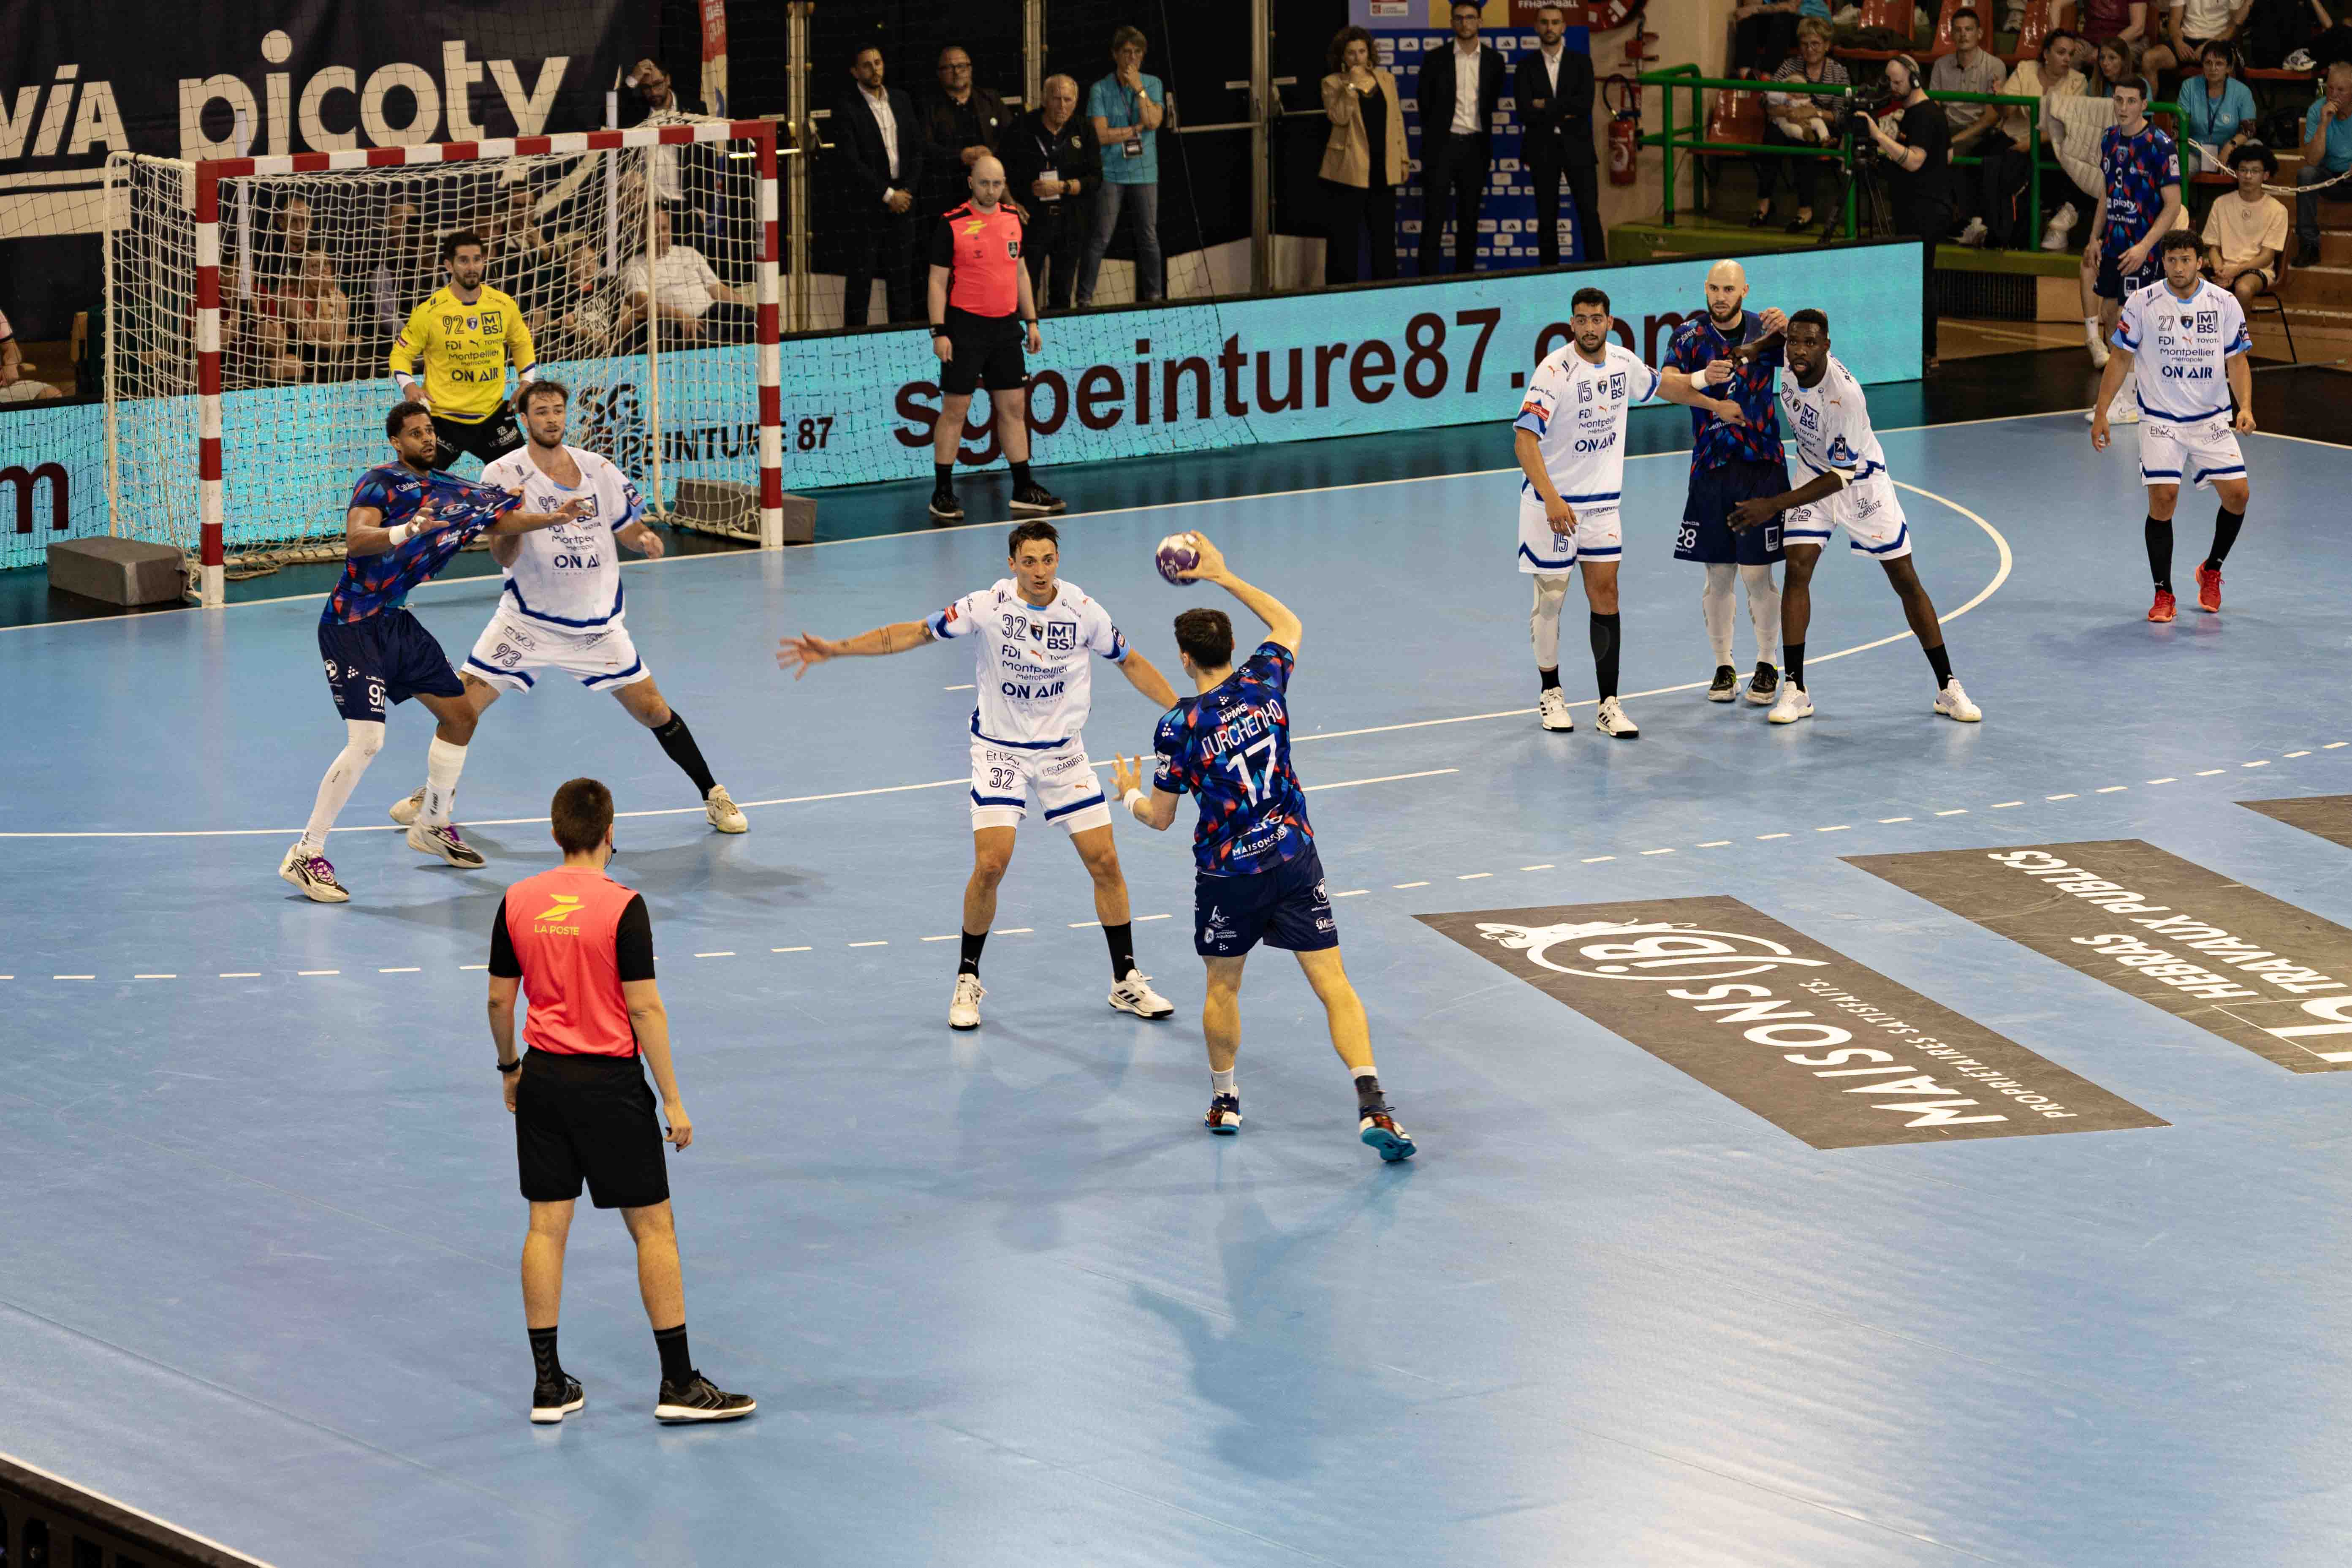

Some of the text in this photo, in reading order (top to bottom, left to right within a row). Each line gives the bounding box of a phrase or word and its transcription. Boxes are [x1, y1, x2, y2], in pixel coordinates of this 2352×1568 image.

[179, 29, 570, 210] picoty
[2115, 167, 2123, 188] 3
[443, 315, 464, 334] 92
[2158, 315, 2175, 332] 27
[451, 367, 498, 382] ON AIR
[2162, 365, 2213, 379] ON AIR
[579, 383, 638, 424] SG
[1577, 380, 1592, 404] 15
[1781, 382, 1794, 408] 22
[797, 417, 834, 451] 87
[1575, 439, 1598, 453] ON
[1787, 507, 1812, 522] 22
[1553, 533, 1569, 553] 15
[554, 554, 582, 568] ON
[1002, 614, 1027, 641] 32
[491, 643, 522, 668] 93
[1001, 681, 1065, 699] ON AIR
[1219, 703, 1248, 724] KPMG
[989, 767, 1015, 791] 32
[1225, 733, 1277, 807] 17
[1232, 834, 1274, 856] MAISONS
[534, 924, 580, 936] LA POSTE
[1988, 851, 2349, 993] TRAVAUX PUBLICS
[2070, 934, 2259, 999] HEBRAS
[1666, 983, 2009, 1128] MAISONS
[1905, 1037, 2078, 1118] PROPRIÉTAIRES
